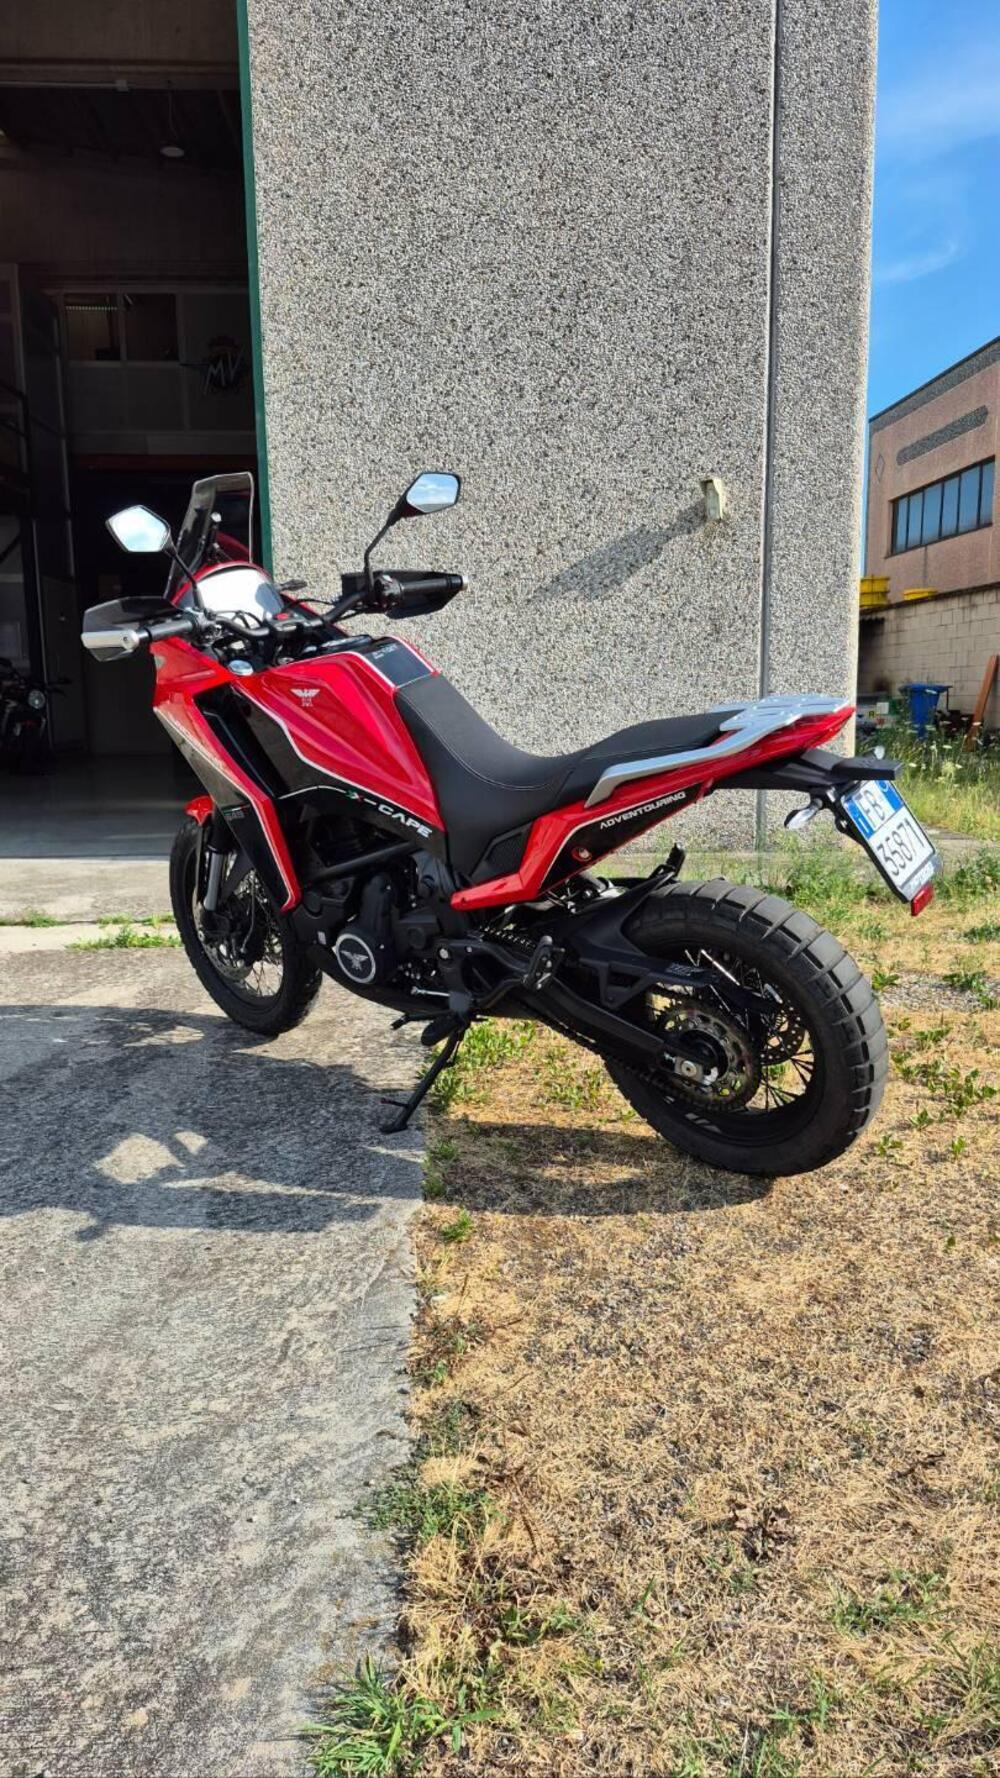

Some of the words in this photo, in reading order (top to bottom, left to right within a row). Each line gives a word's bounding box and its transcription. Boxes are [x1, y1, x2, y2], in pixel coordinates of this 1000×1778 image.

[600, 791, 686, 830] ADVENTOURING
[857, 790, 886, 828] FB
[876, 817, 926, 877] 35871
